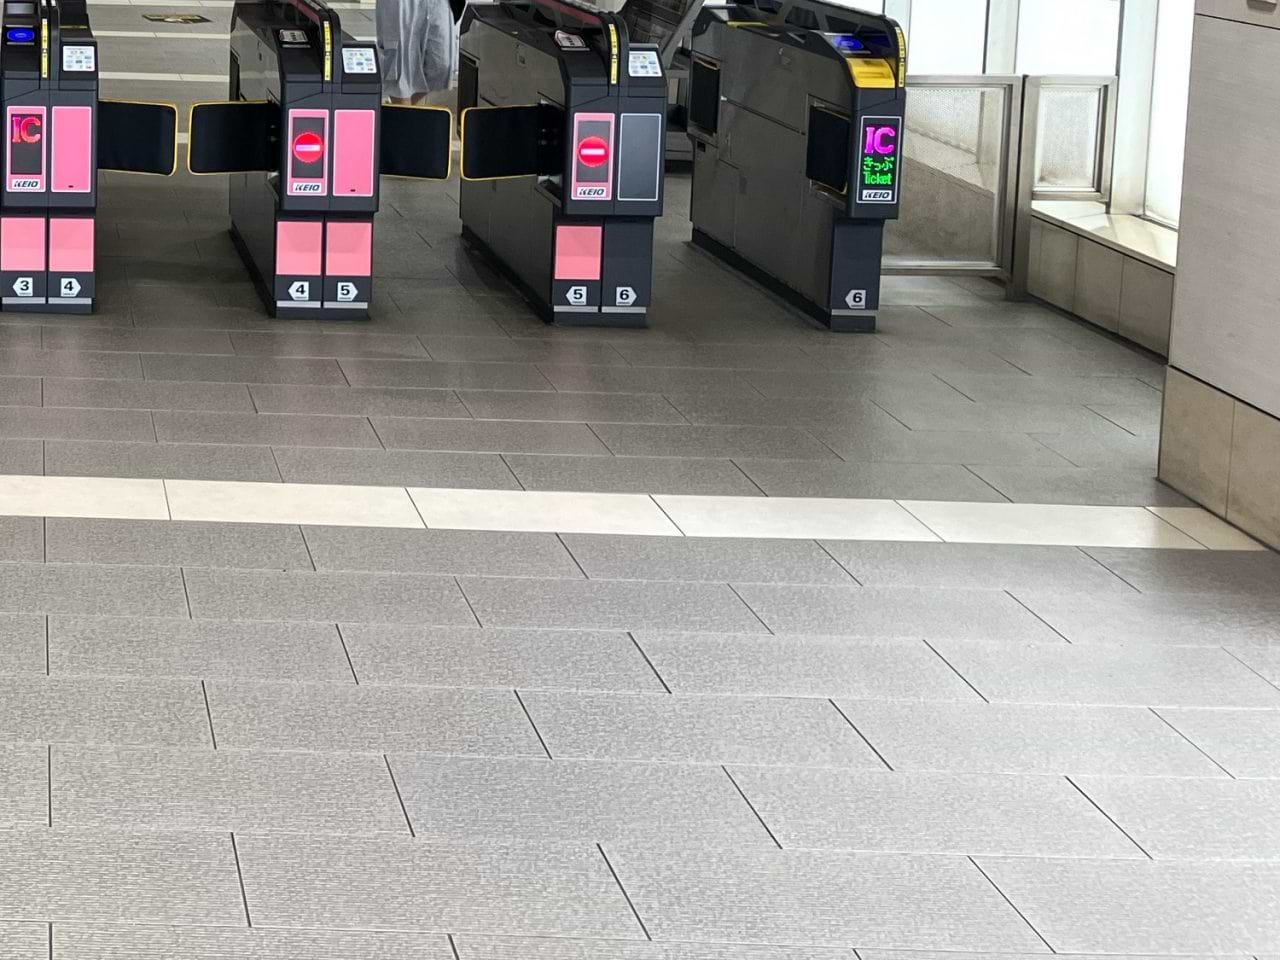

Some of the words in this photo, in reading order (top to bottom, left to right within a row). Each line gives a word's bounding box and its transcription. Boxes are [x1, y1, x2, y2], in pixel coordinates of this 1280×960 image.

[11, 116, 41, 144] IC
[864, 126, 896, 154] IC
[862, 156, 895, 171] きっぷ
[13, 180, 39, 188] KEIO
[863, 172, 892, 185] Ticket
[295, 184, 320, 192] KEIO
[578, 188, 605, 196] KEIO
[864, 191, 891, 200] KEIO
[20, 280, 29, 291] 3
[64, 280, 74, 291] 4
[295, 284, 306, 295] 4
[340, 285, 350, 295] 5
[573, 289, 583, 300] 5
[619, 289, 629, 300] 6
[852, 292, 863, 303] 6
